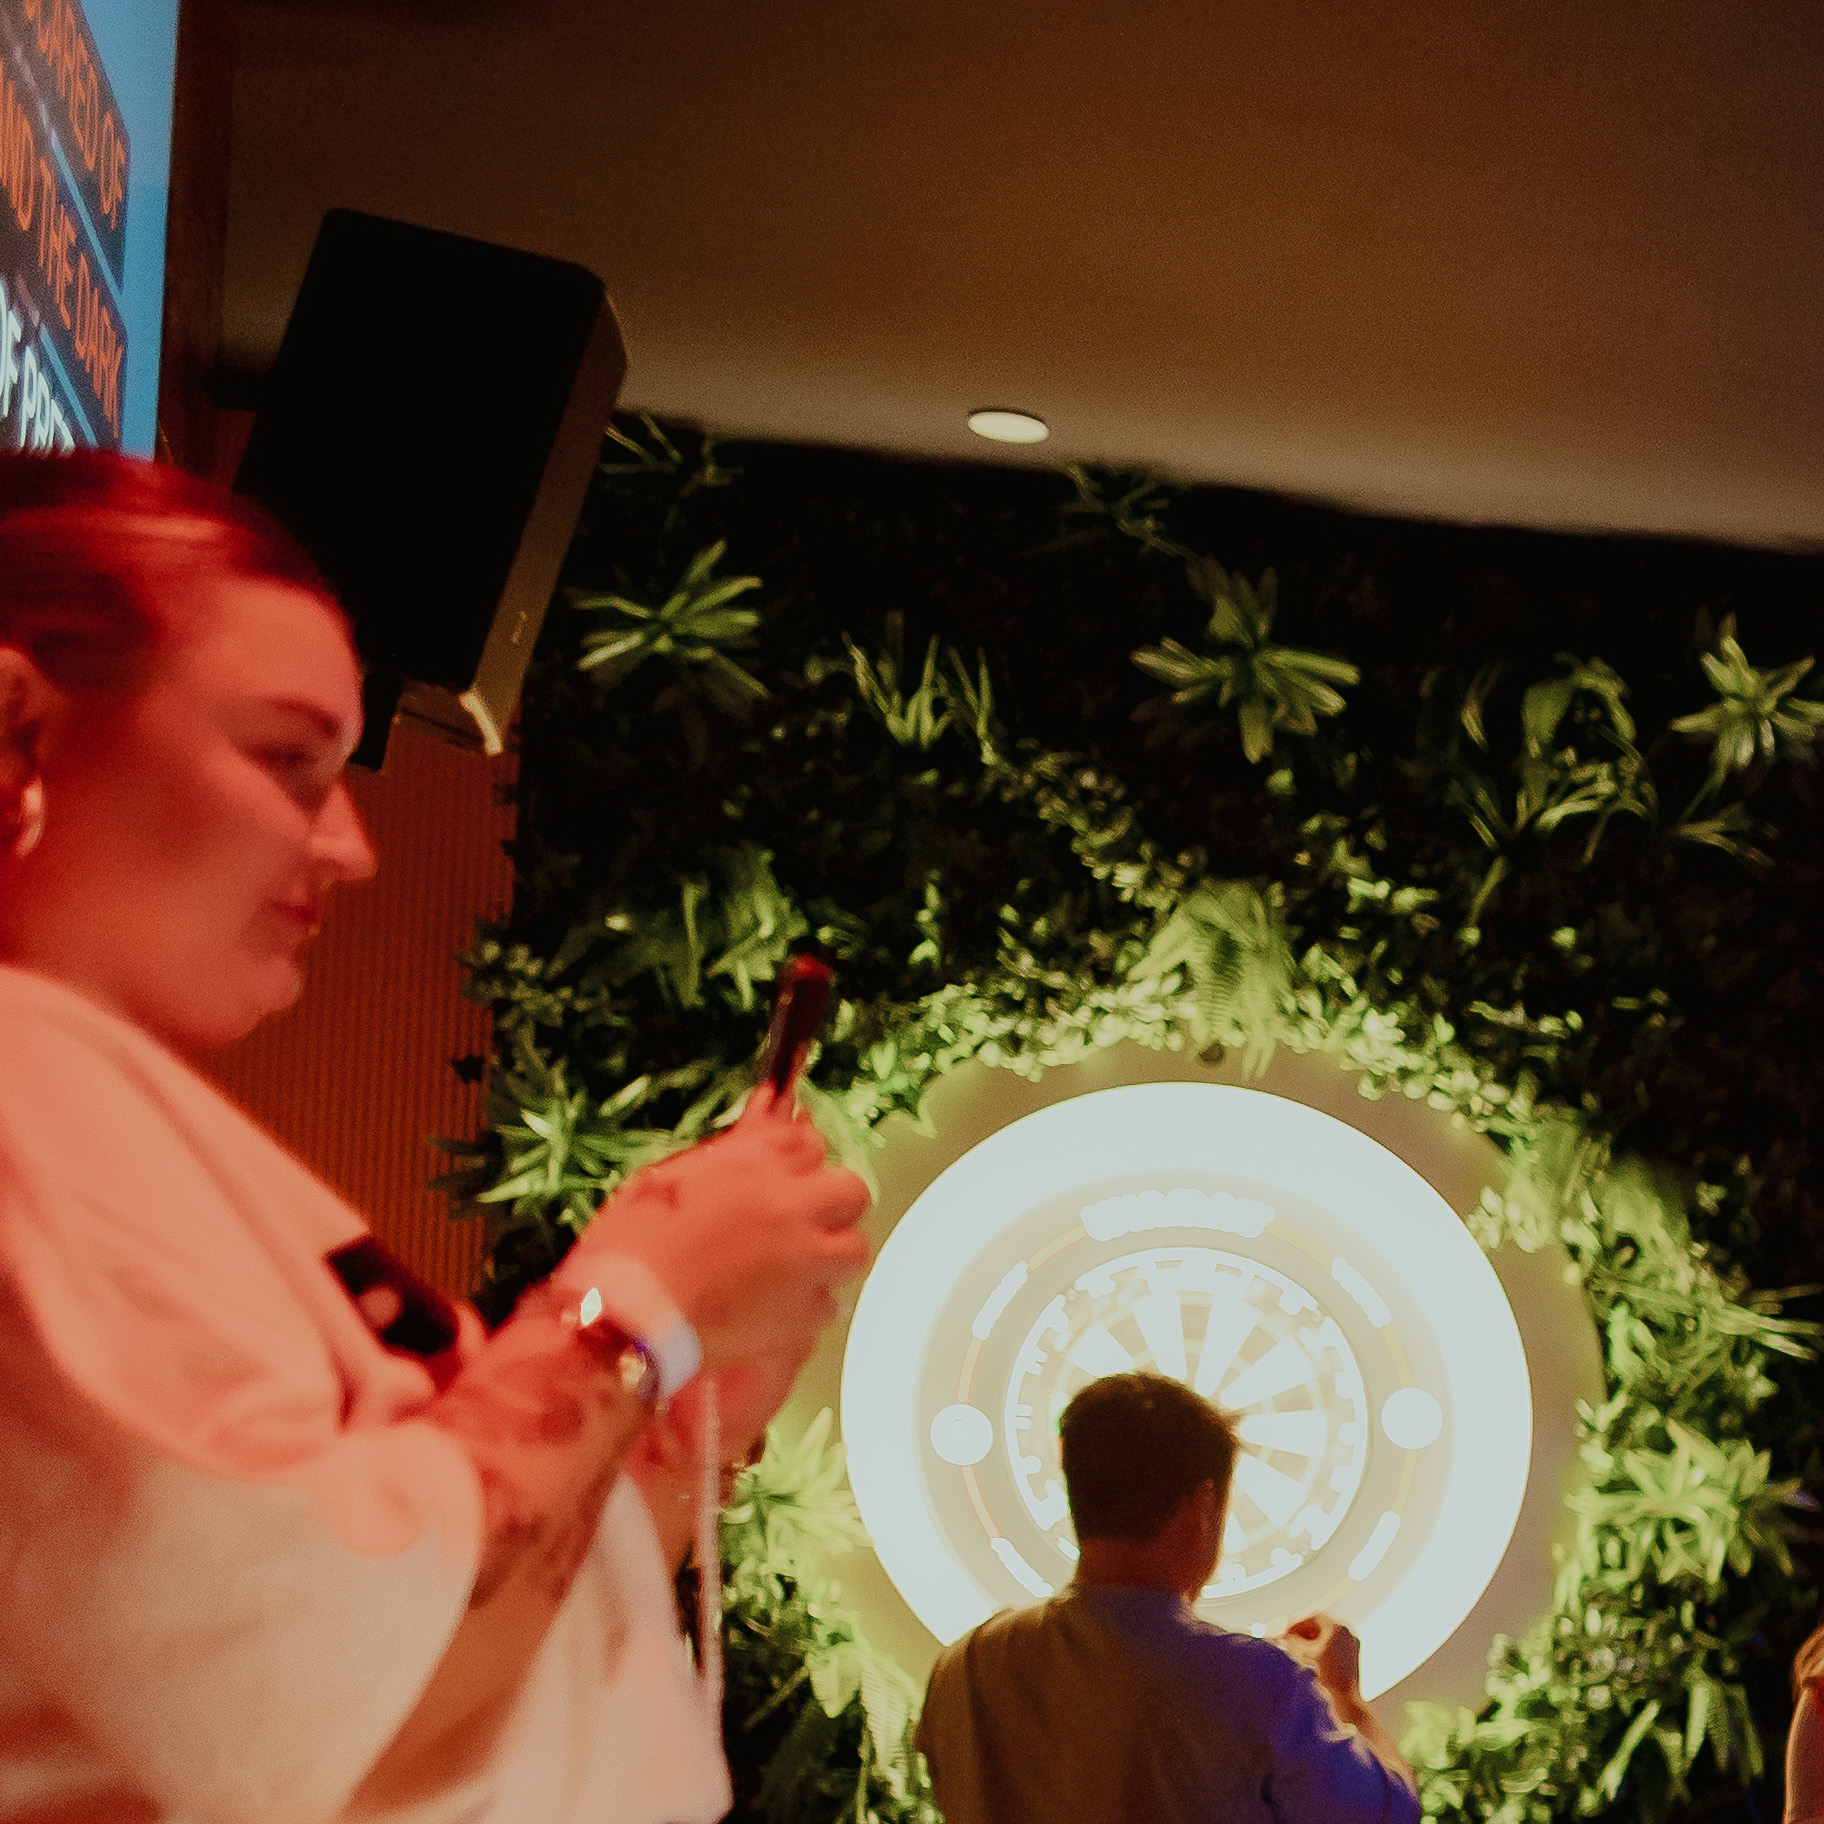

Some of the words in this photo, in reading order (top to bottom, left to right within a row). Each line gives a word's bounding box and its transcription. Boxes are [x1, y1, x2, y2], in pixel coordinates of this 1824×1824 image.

[24, 0, 98, 172] CARED
[100, 109, 126, 231] OF
[38, 154, 76, 332] THE
[74, 251, 124, 440] DARK
